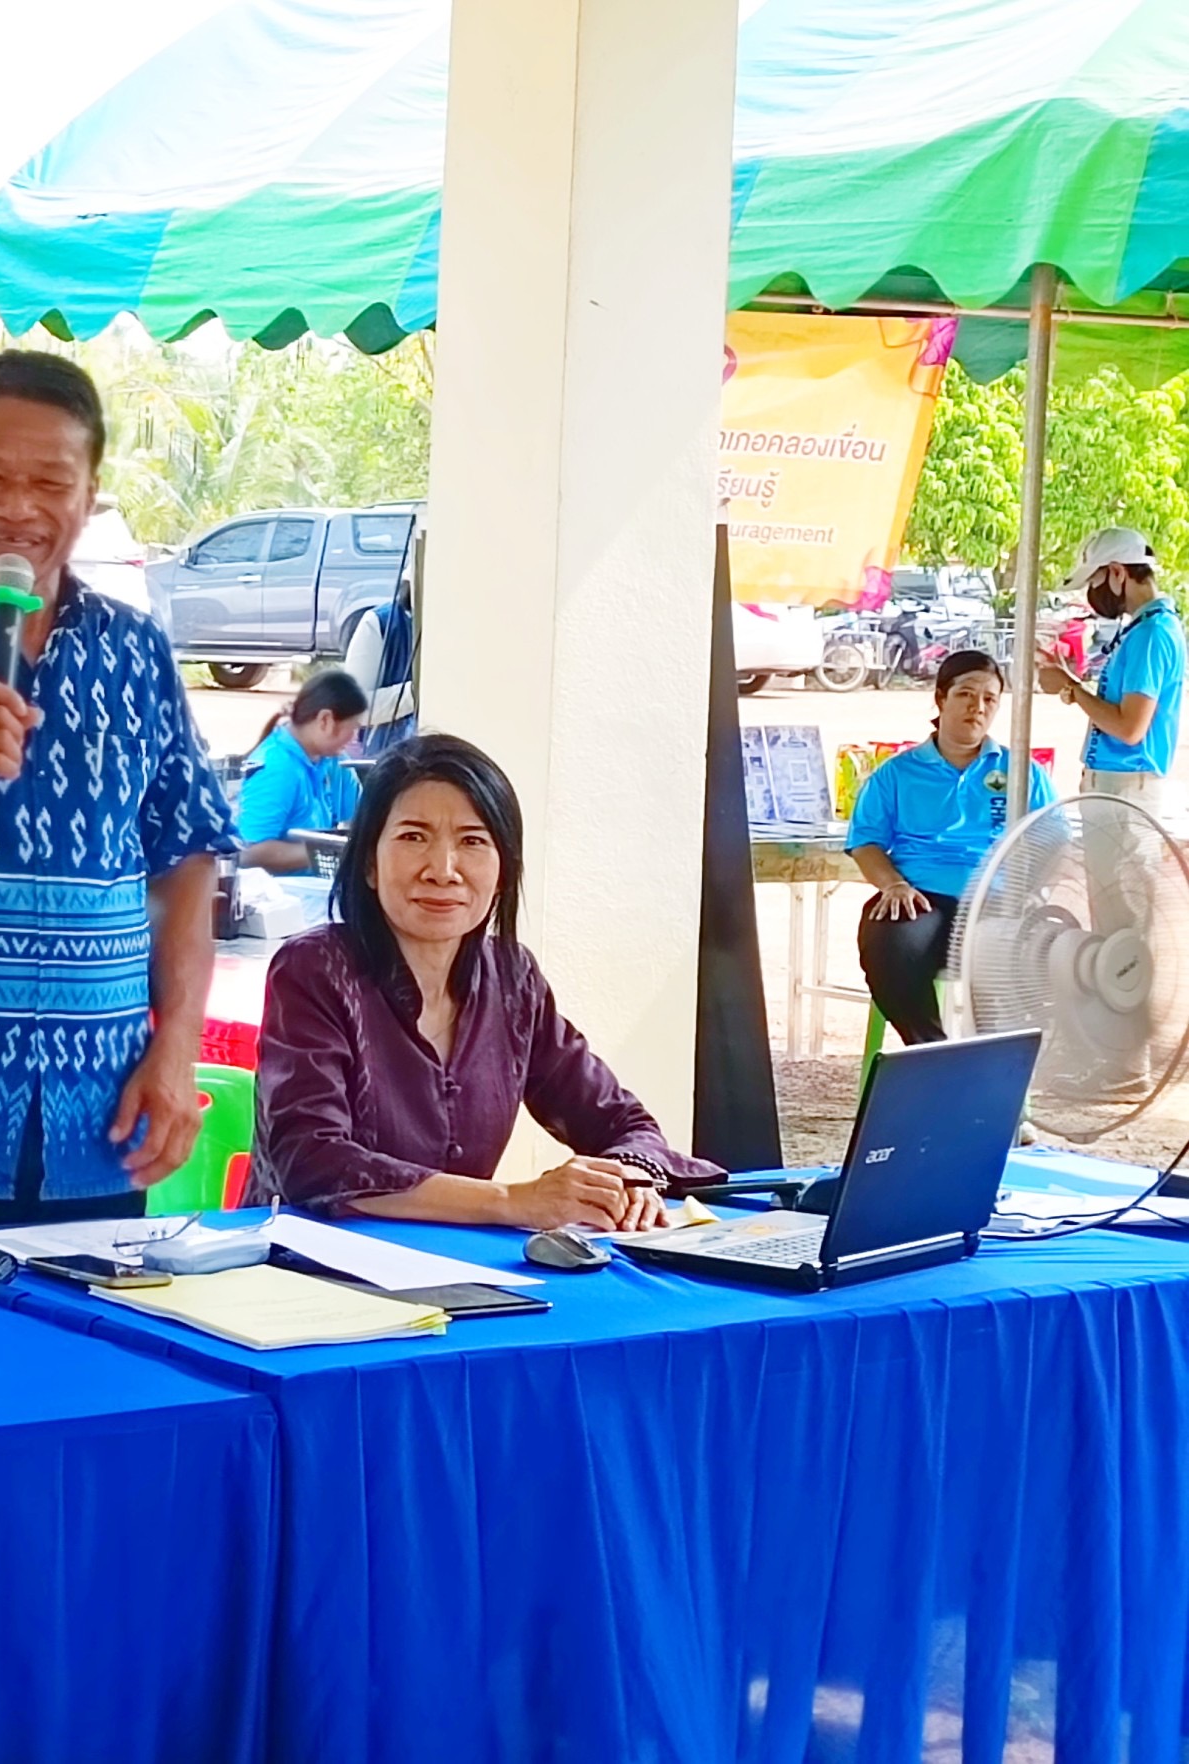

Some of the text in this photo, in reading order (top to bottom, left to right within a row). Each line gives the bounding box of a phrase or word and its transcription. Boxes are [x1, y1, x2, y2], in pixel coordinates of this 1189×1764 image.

[716, 468, 780, 508] รียนรู้
[729, 523, 834, 545] uragement
[865, 1147, 895, 1164] acer
